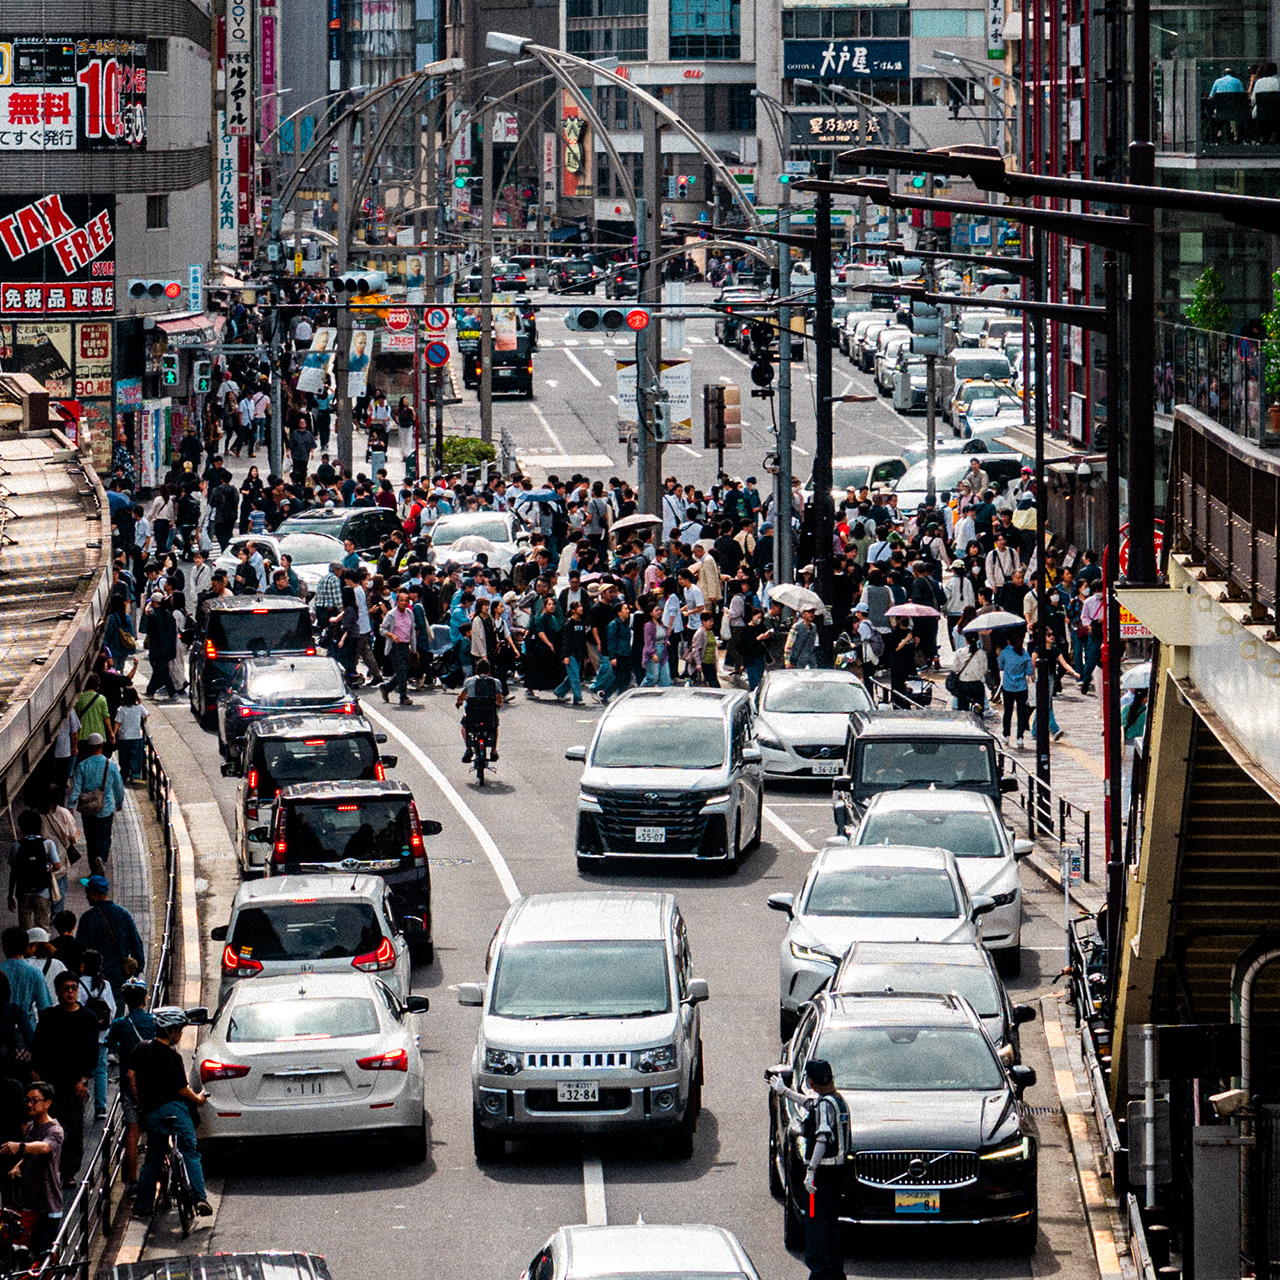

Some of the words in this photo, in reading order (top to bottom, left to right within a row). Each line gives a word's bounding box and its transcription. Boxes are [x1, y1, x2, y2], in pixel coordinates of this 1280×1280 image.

[820, 42, 871, 77] 大戸屋
[8, 92, 72, 125] 無料
[229, 65, 248, 125] ルノアール
[231, 126, 247, 134] B1F
[0, 193, 77, 262] TAX
[51, 208, 114, 277] FREE
[4, 287, 113, 309] 免税品取扱店
[566, 1089, 596, 1100] 32-84
